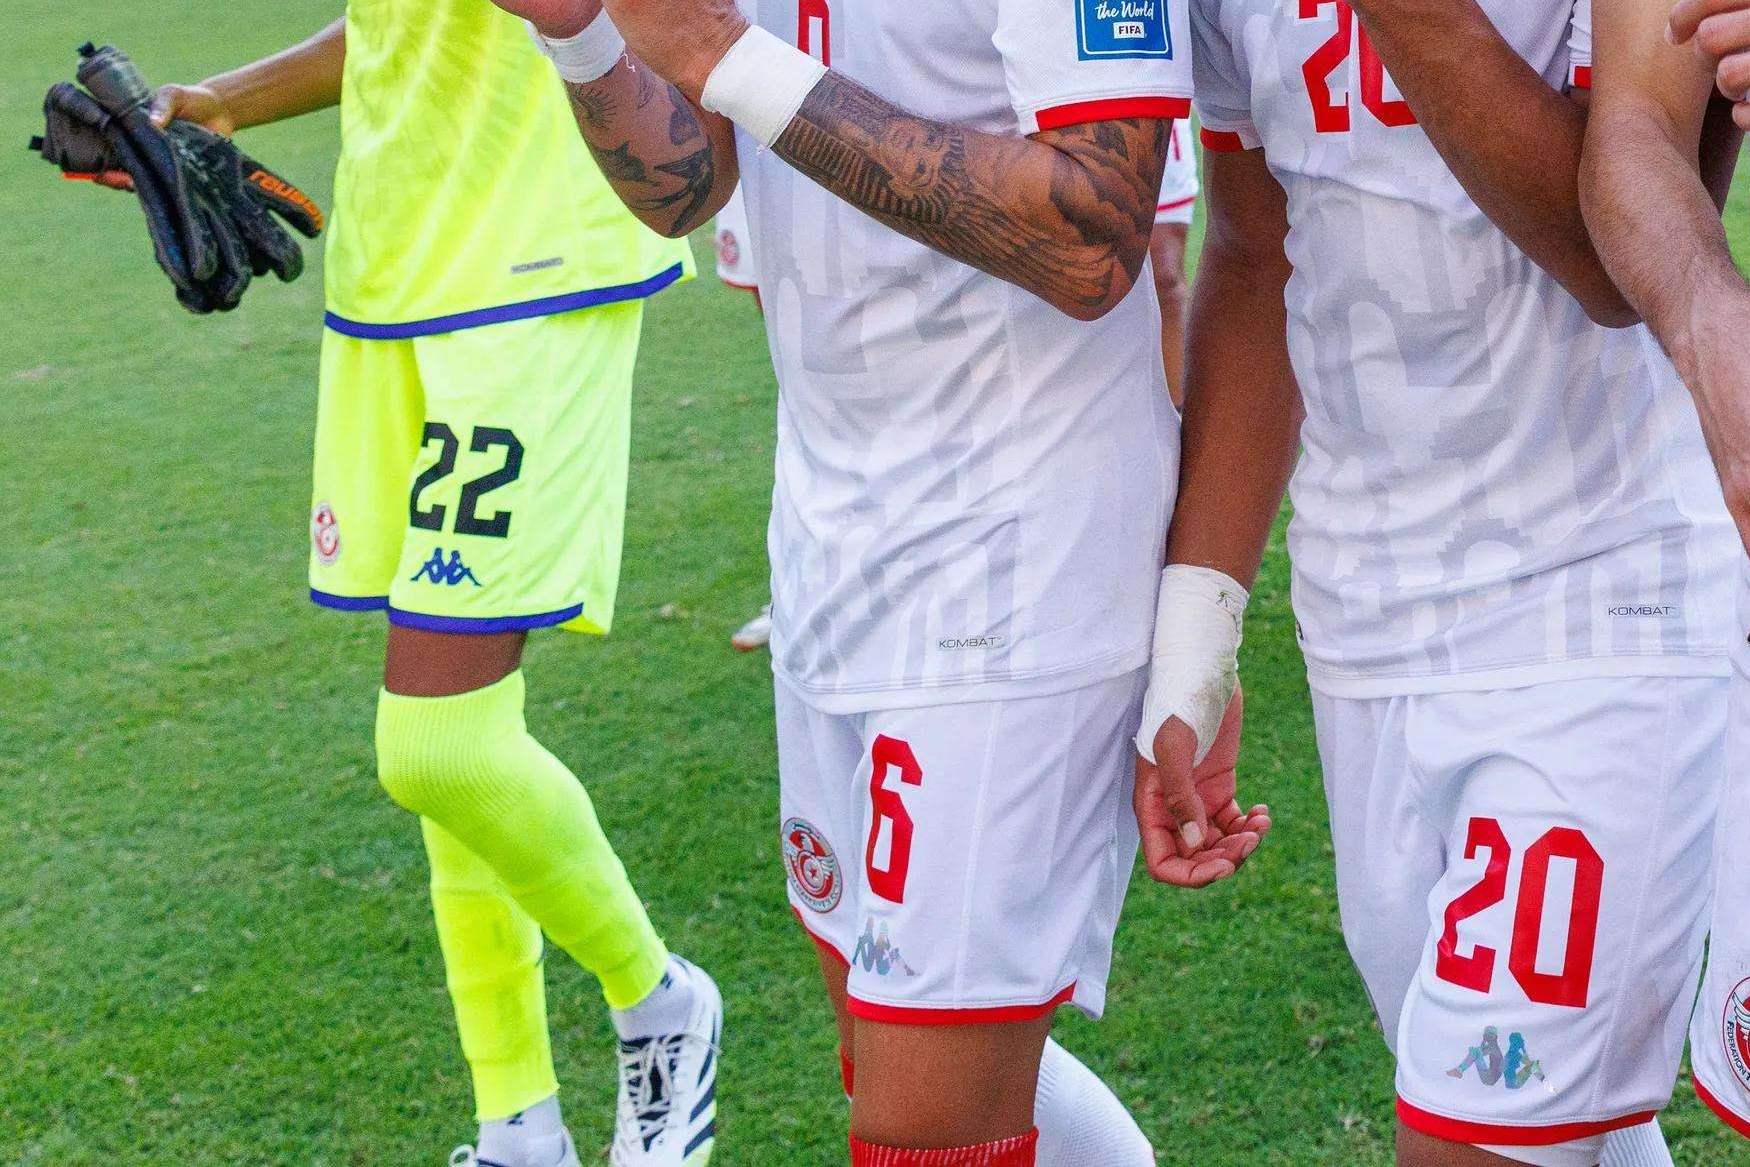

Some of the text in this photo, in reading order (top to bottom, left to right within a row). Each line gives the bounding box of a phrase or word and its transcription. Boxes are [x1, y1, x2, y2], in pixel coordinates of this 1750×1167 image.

[1095, 0, 1155, 21] the World
[1118, 25, 1142, 35] FIFA
[409, 422, 525, 539] 22
[1608, 606, 1671, 616] KOMBAT
[865, 733, 923, 904] 6
[1436, 817, 1605, 1009] 20
[1727, 1020, 1747, 1076] FEDERATION
